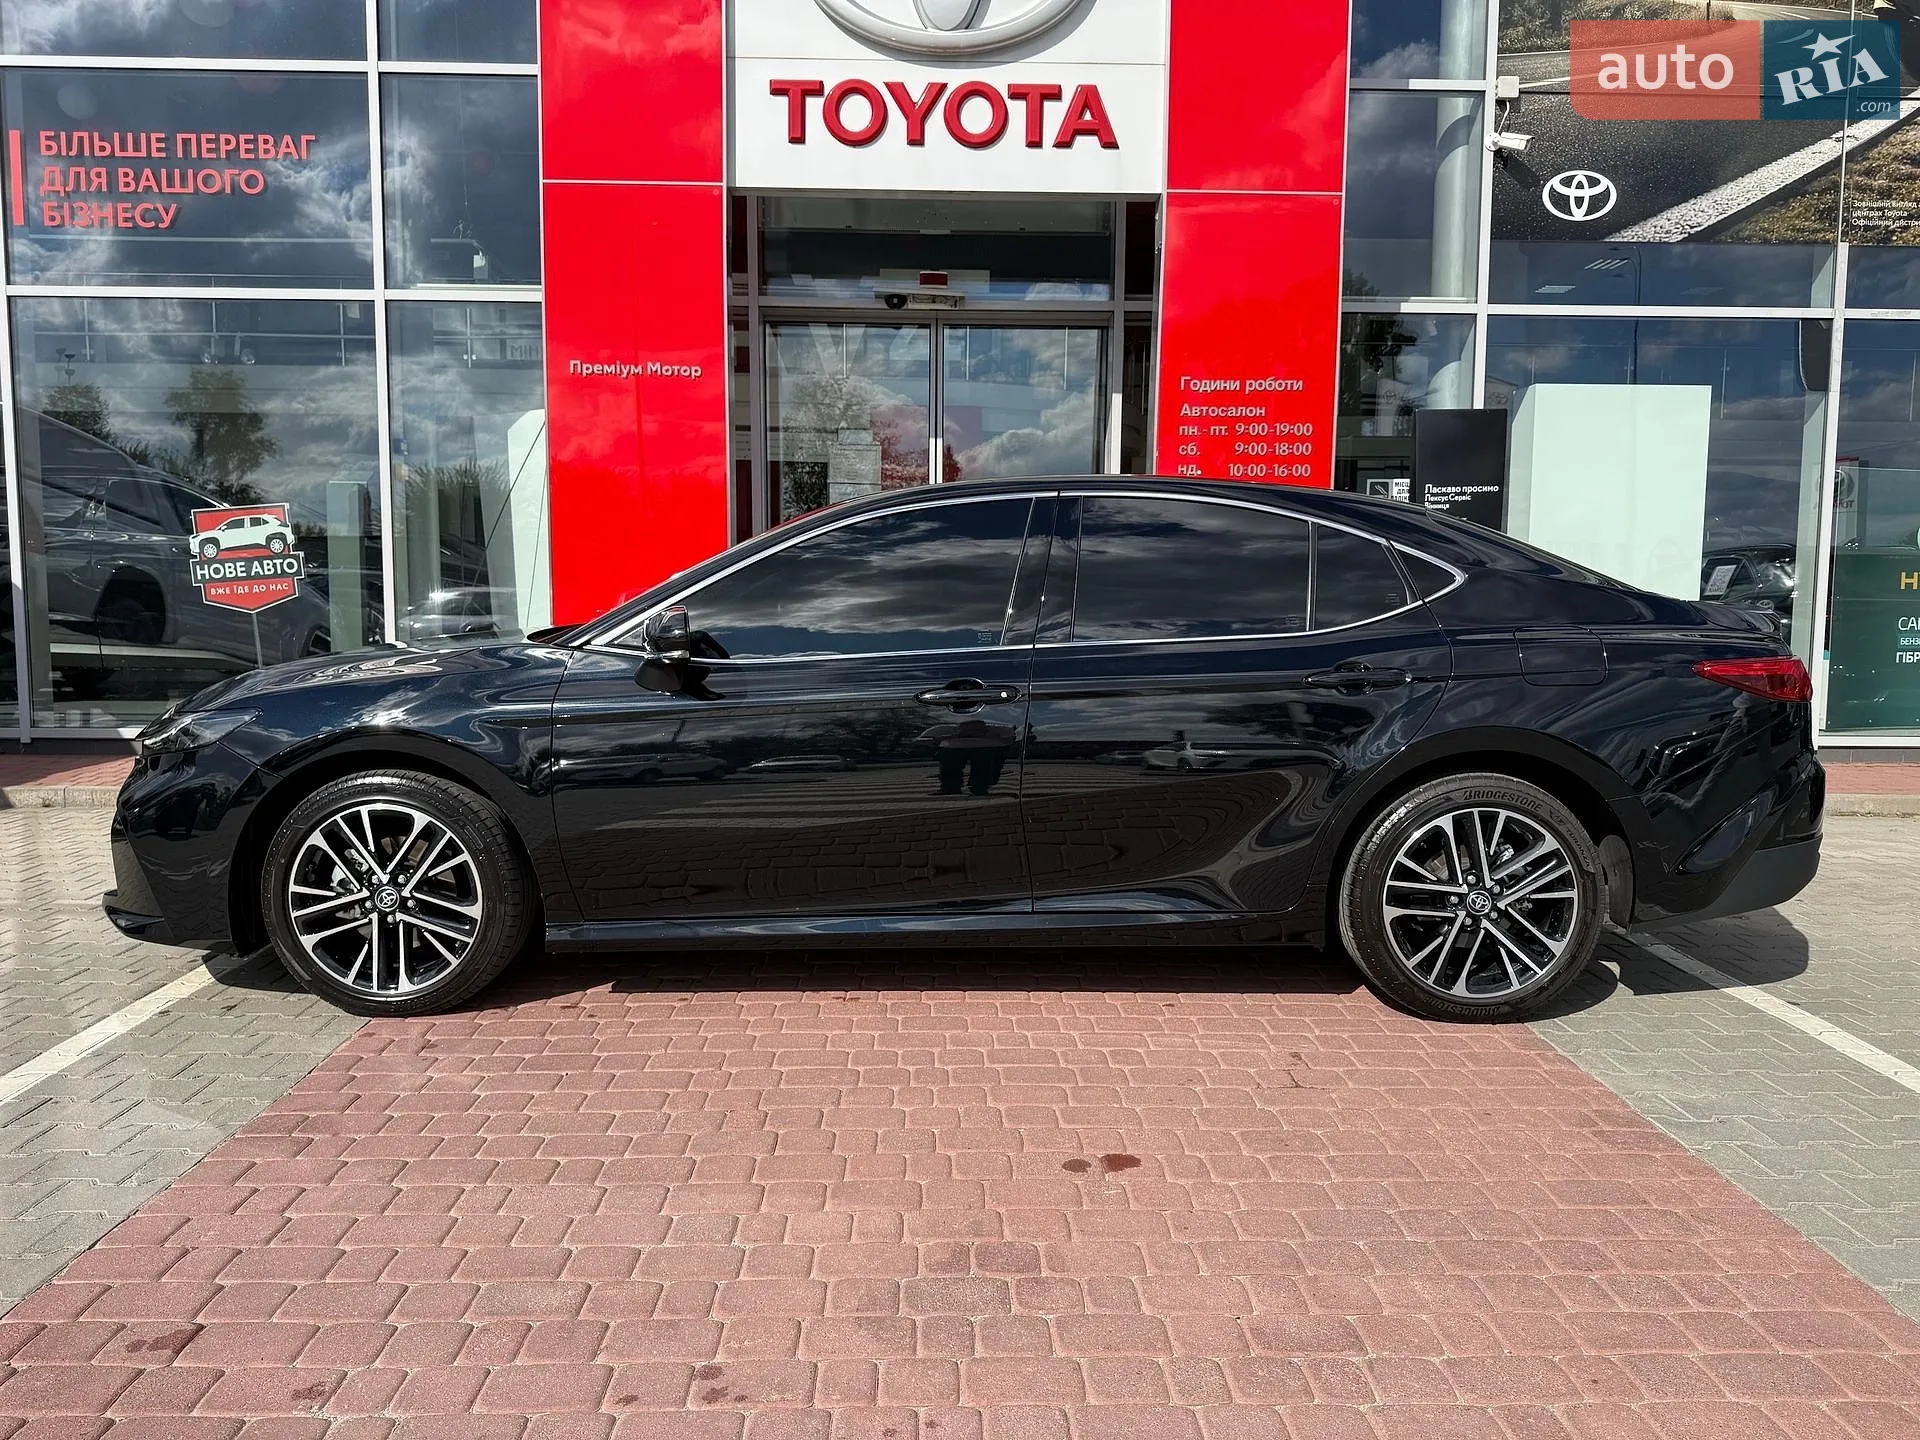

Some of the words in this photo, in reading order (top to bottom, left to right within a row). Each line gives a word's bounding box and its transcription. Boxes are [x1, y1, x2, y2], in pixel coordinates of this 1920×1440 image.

[769, 78, 1120, 149] TOYOTA
[39, 130, 167, 158] БІЛЬШЕ
[177, 133, 317, 160] ПЕРЕВАГ
[39, 166, 108, 197] ДЛЯ
[117, 168, 266, 194] ВАШОГО
[42, 202, 178, 228] БІЗНЕСУ
[1884, 209, 1908, 217] Toyota
[569, 359, 643, 378] Преміум
[647, 361, 702, 379] Мотор
[1180, 376, 1240, 393] Години
[1245, 376, 1303, 394] роботи
[1179, 403, 1266, 417] Автосалон
[1235, 422, 1313, 436] 9:00-19:00
[1179, 443, 1201, 456] сб.
[1234, 442, 1312, 456] 9:00-18:00
[1228, 463, 1311, 477] 10:00-16:00
[1424, 484, 1462, 494] Ласкаво
[1462, 485, 1499, 494] просимо
[1424, 494, 1449, 502] Лексус
[1449, 493, 1472, 502] Сервіс
[196, 561, 247, 580] НОВЕ
[250, 558, 298, 577] АВТО
[210, 587, 231, 596] ВЖЕ
[233, 585, 250, 595] ЇДЕ
[252, 584, 267, 593] ДО
[269, 582, 289, 591] НАС
[1463, 790, 1544, 812] BRIDGESTONE
